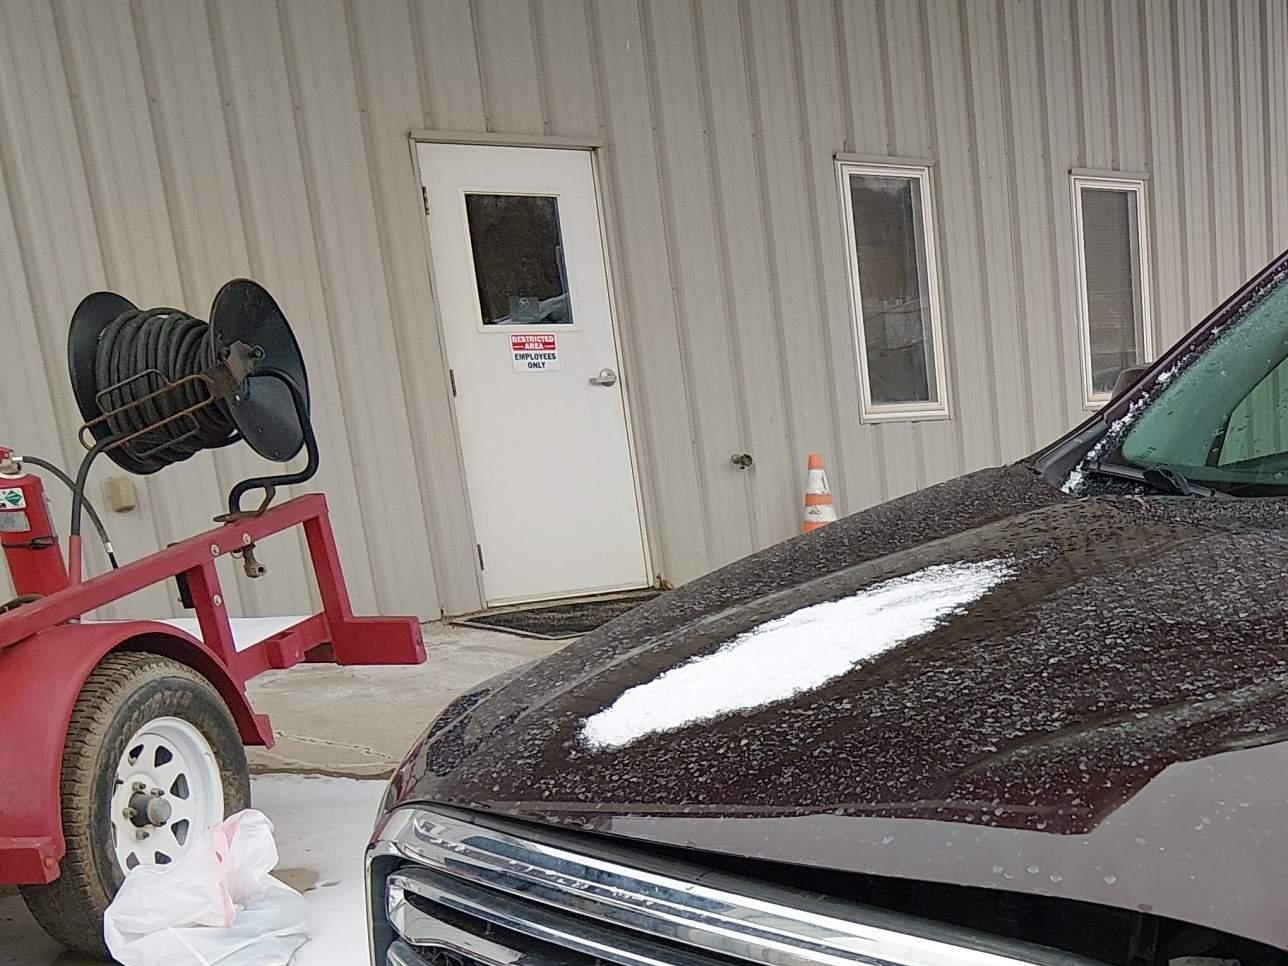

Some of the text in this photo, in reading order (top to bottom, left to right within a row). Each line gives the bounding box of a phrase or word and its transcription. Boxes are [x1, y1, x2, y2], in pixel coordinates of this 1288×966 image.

[511, 335, 554, 343] RESTRICTED
[524, 342, 544, 350] AREA
[514, 352, 557, 361] EMPLOYEES
[527, 361, 546, 369] ONLY
